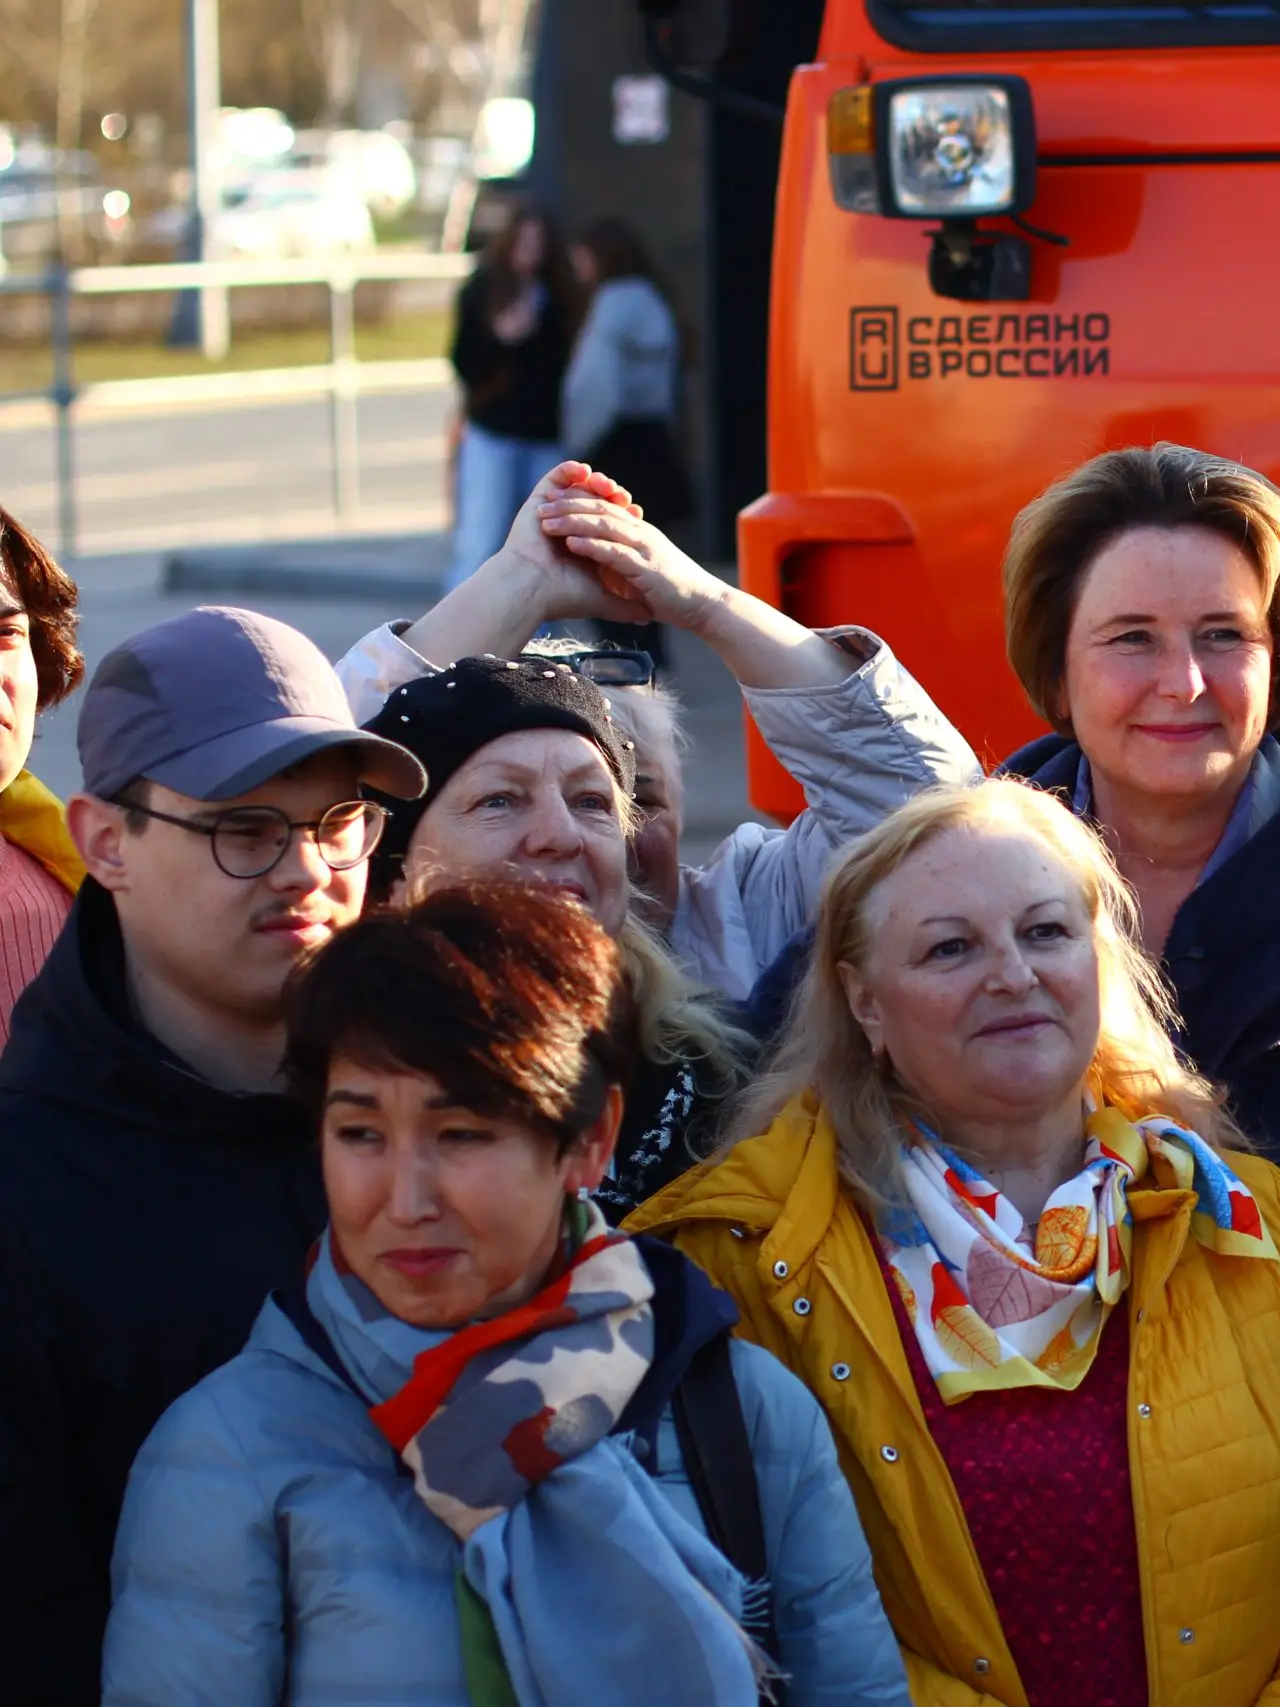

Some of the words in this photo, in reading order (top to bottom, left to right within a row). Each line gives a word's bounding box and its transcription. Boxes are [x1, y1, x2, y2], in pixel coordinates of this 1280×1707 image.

[908, 313, 1110, 346] СДЕЛАНО
[908, 351, 931, 379] В
[940, 347, 1110, 378] РОССИИ
